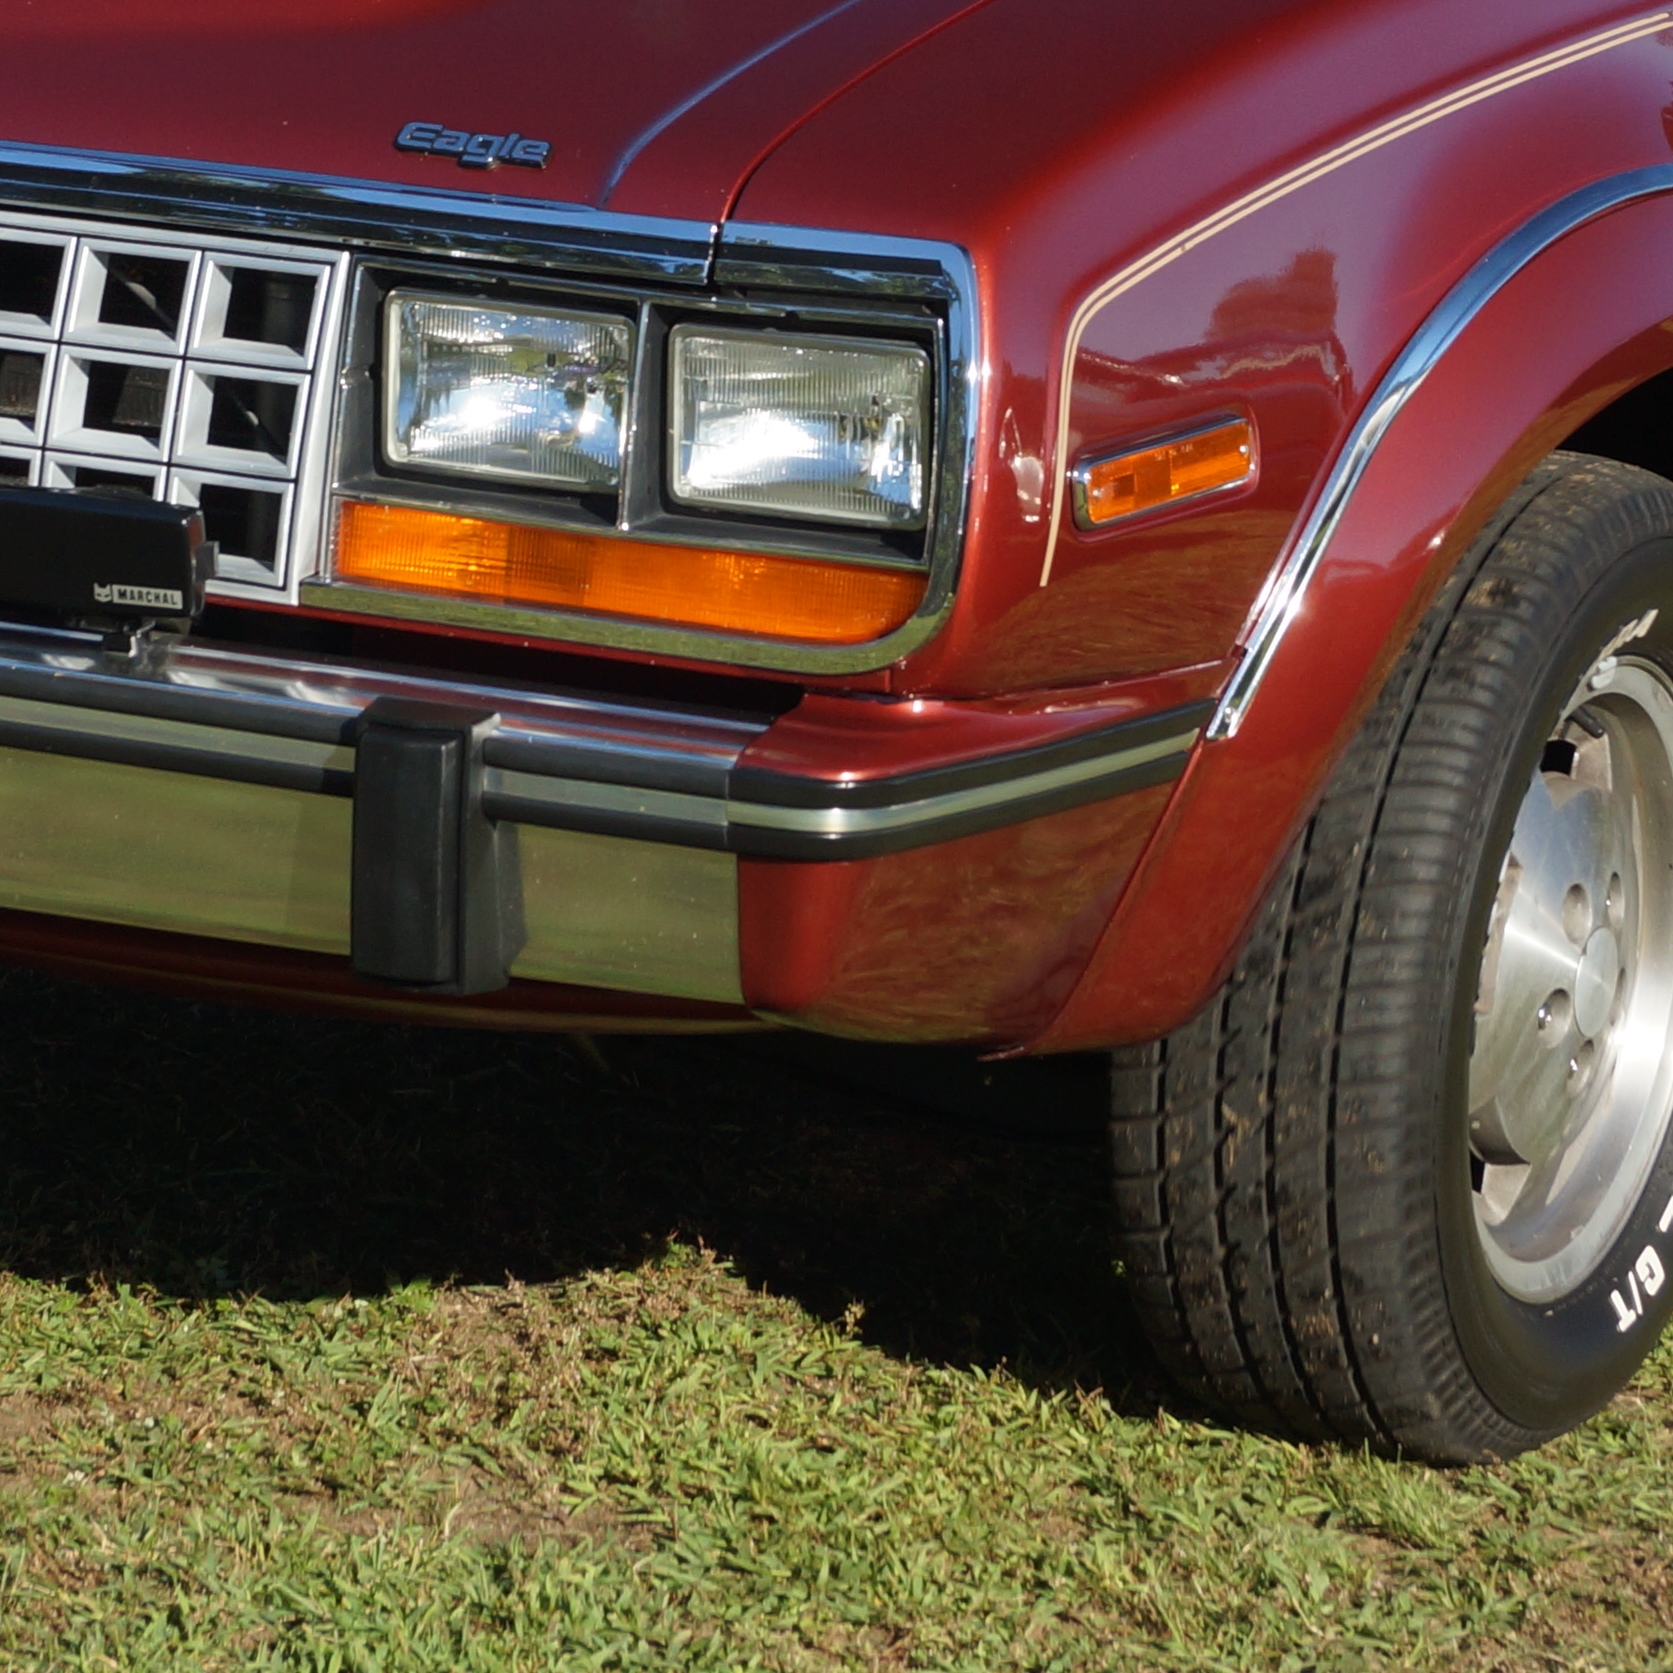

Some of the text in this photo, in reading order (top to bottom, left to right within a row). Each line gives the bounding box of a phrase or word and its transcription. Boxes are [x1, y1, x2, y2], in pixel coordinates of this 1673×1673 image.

[394, 120, 553, 167] Eagle
[117, 587, 178, 606] MARCHAL
[1609, 1244, 1666, 1333] G/T
